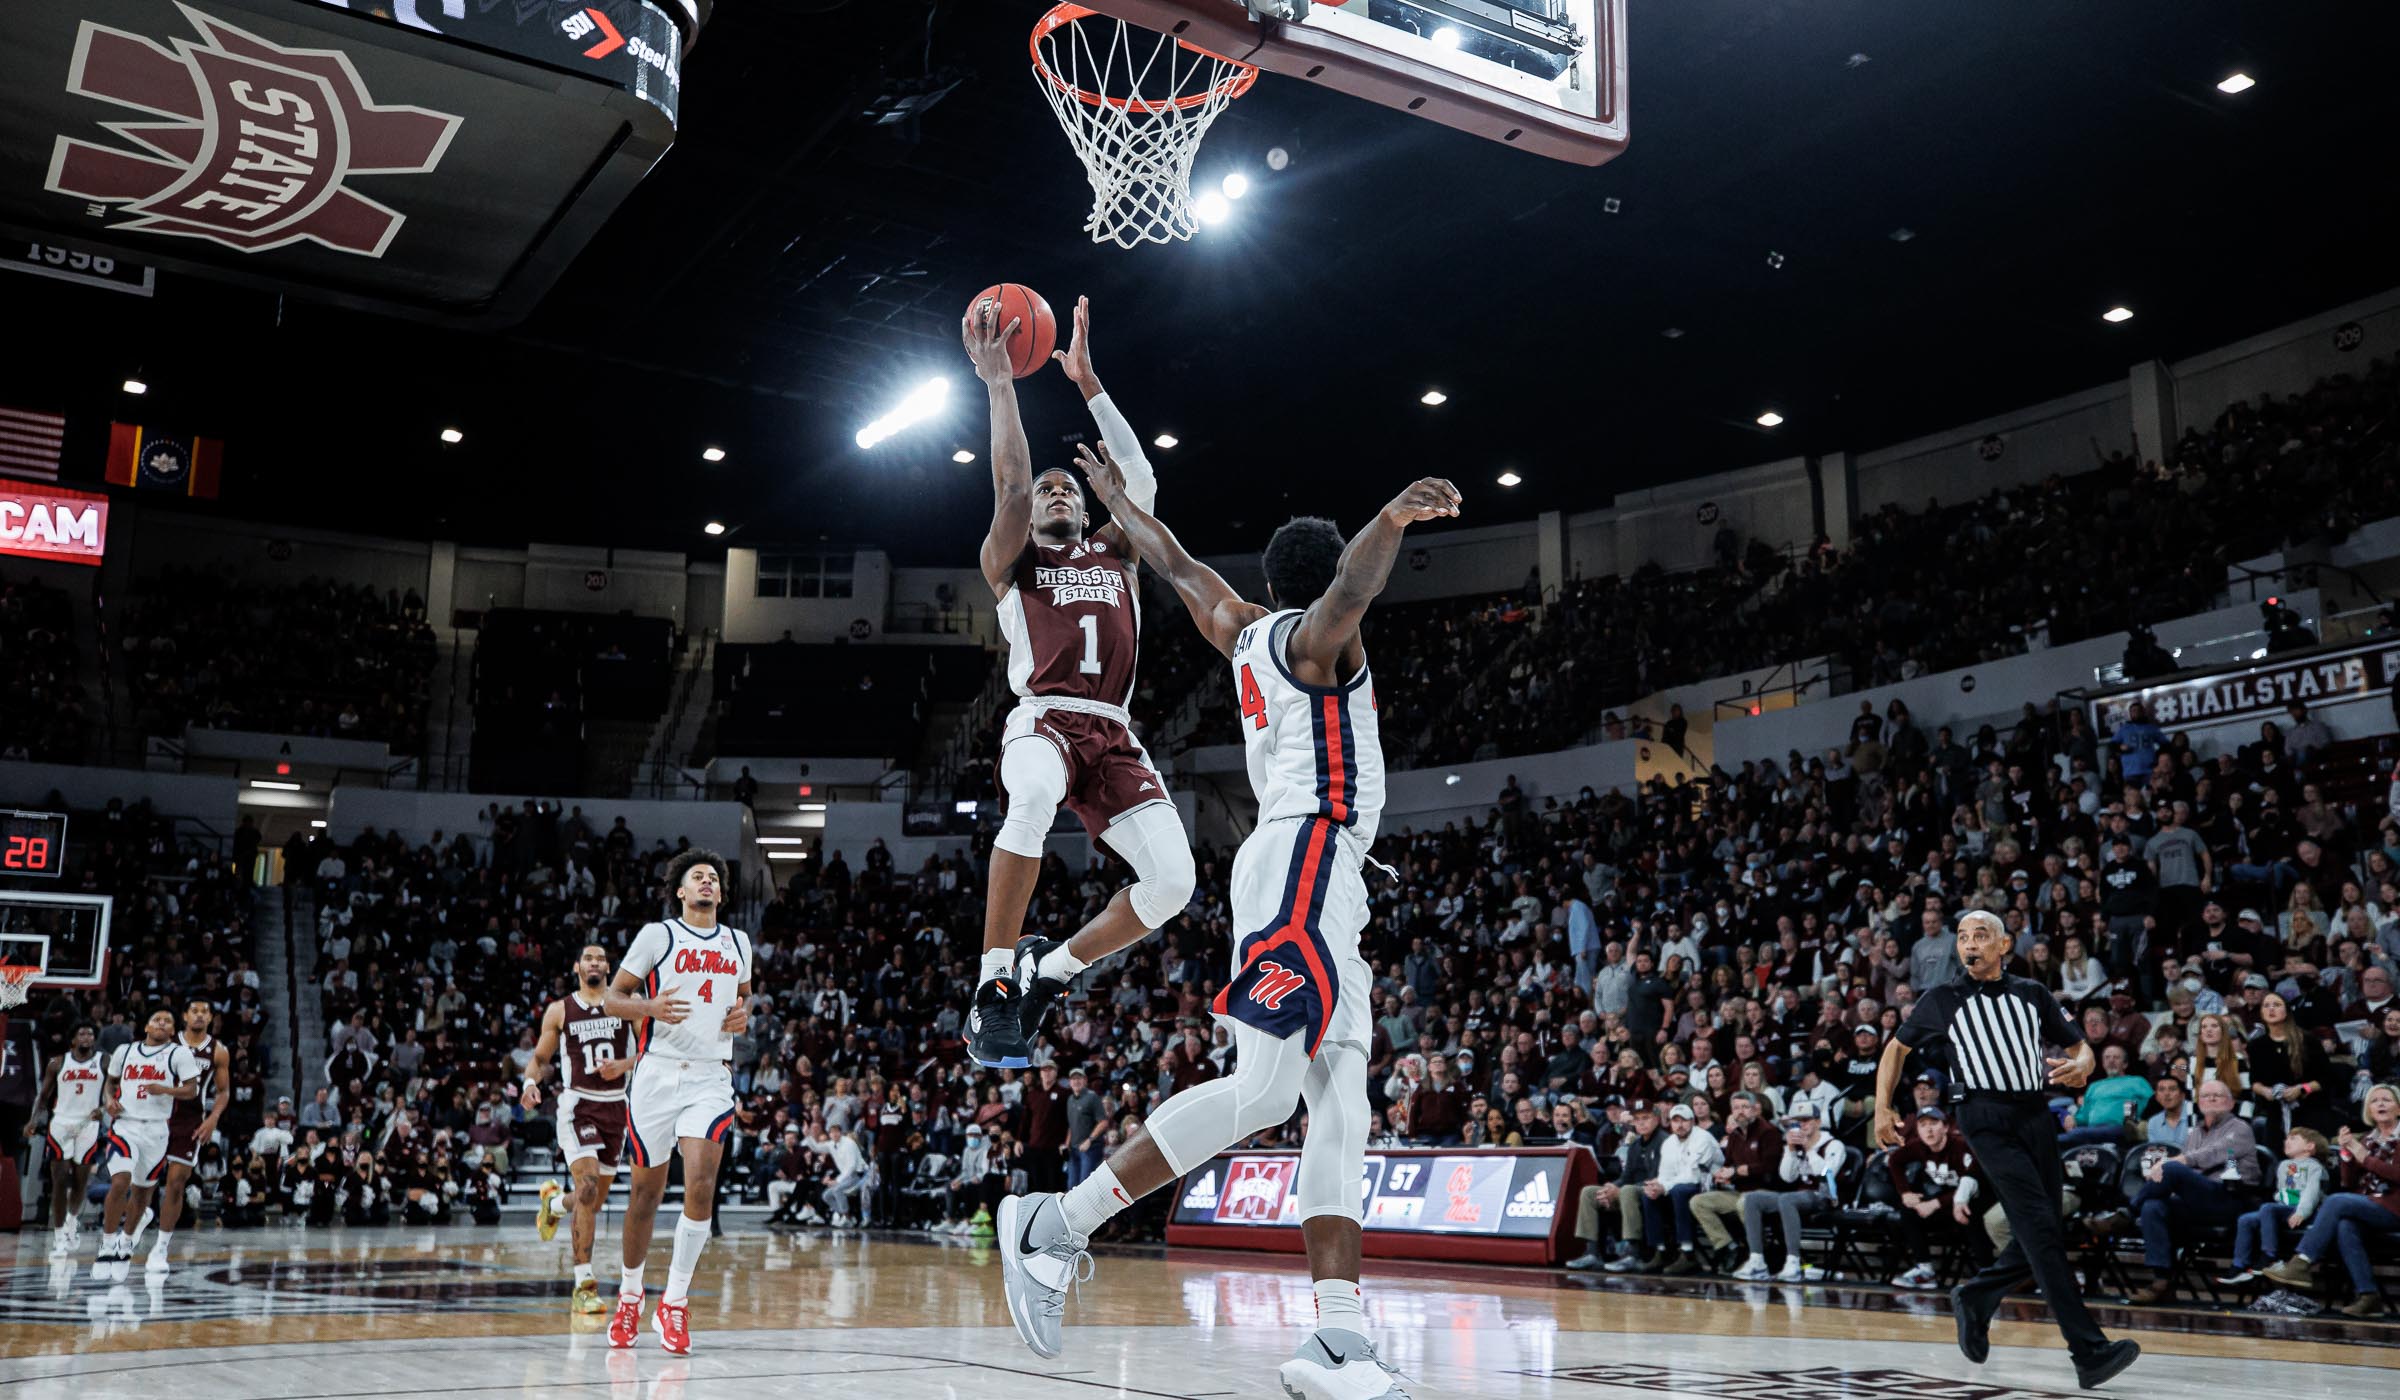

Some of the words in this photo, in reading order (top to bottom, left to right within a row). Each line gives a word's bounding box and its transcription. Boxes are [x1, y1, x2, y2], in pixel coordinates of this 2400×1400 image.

[561, 10, 595, 40] SDI
[627, 36, 666, 71] Steel
[199, 79, 319, 221] STATE
[0, 501, 98, 547] CAM
[585, 573, 604, 587] 203
[1036, 568, 1124, 589] MISSISSIPPI
[1065, 587, 1111, 601] STATE
[1079, 614, 1101, 675] 1
[1240, 662, 1269, 731] 4
[2154, 656, 2366, 723] #HAILSTATE
[280, 741, 292, 755] A
[5, 836, 48, 868] 28
[675, 948, 702, 974] Ole
[701, 949, 737, 976] Miss
[697, 979, 713, 1004] 4
[75, 1083, 84, 1095] 3
[1388, 1164, 1421, 1191] 57
[1506, 1200, 1556, 1217] adidas
